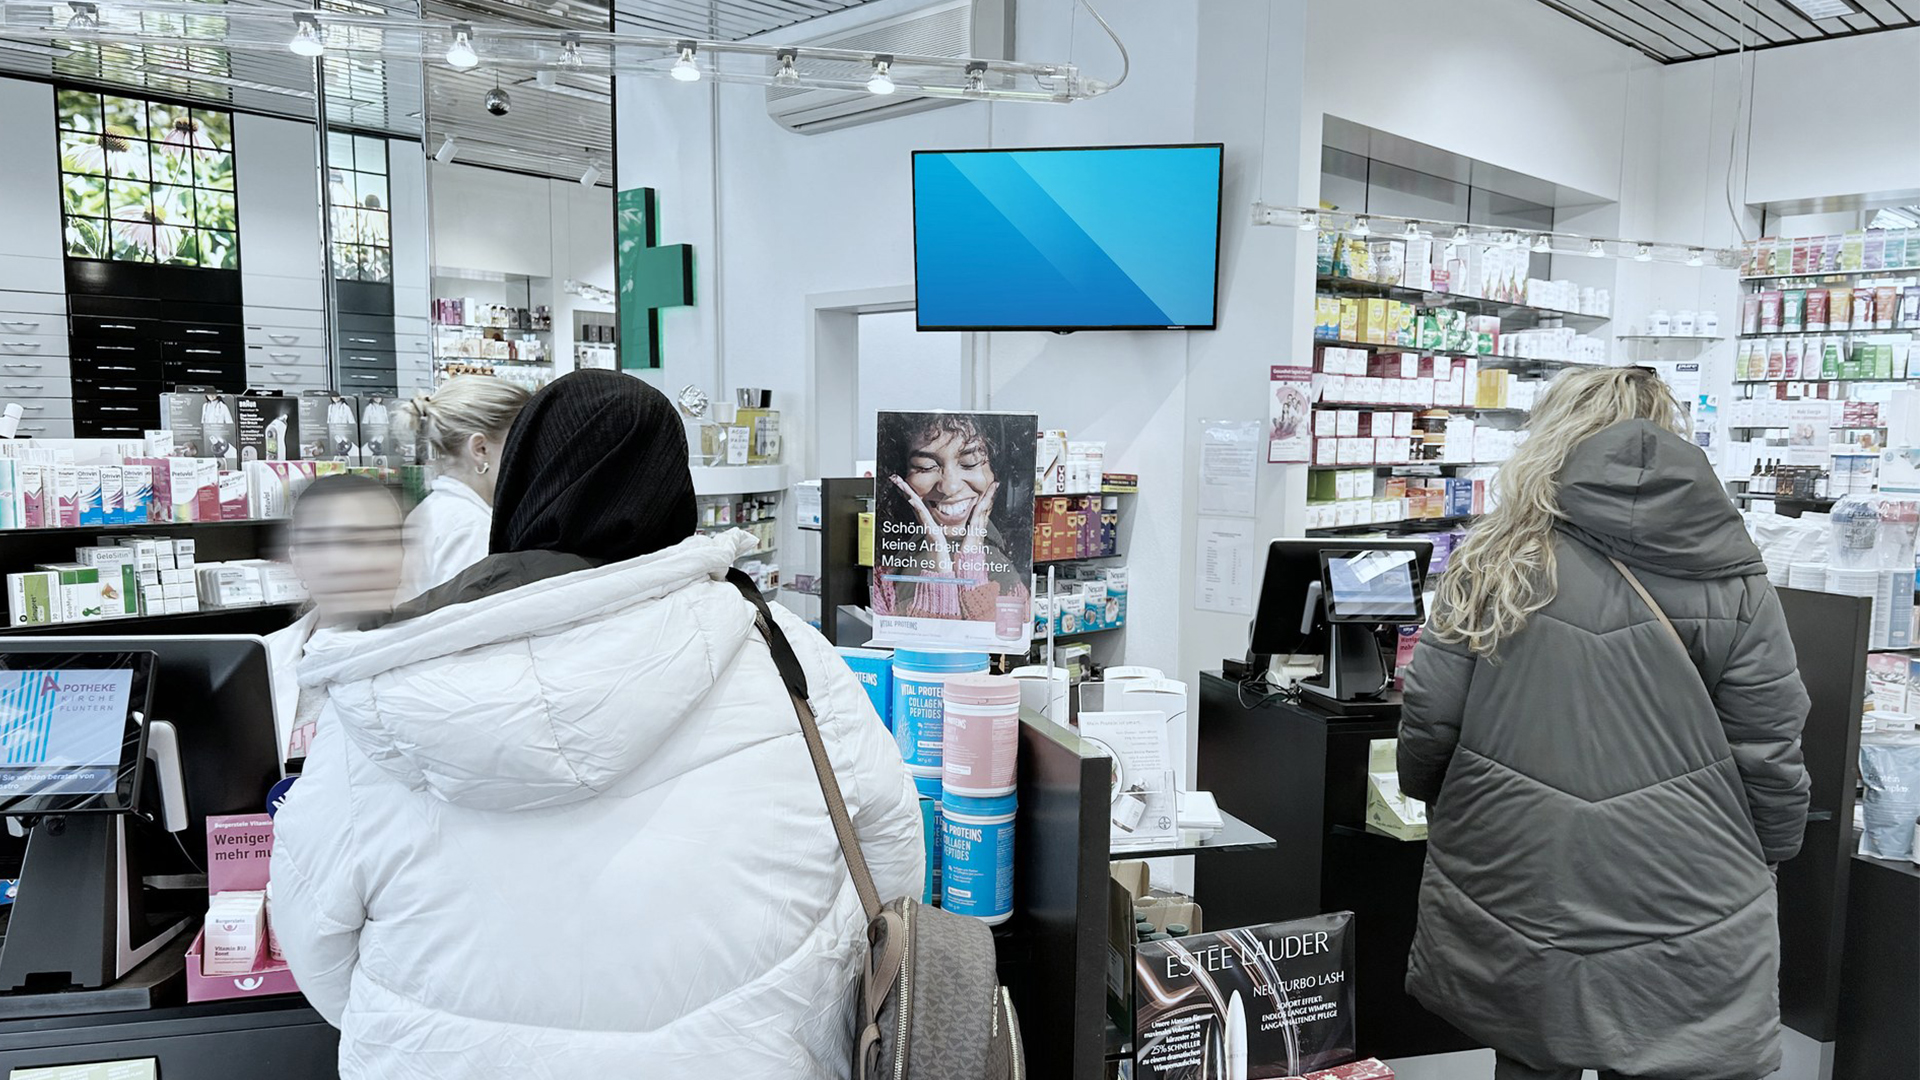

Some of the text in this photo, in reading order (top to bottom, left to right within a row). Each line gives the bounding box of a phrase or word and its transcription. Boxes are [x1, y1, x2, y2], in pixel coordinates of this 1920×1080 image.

[882, 520, 988, 537] Schönheit sollte
[882, 538, 993, 555] keine Arbeit sein.
[882, 554, 1011, 573] Mach es dir leichter.
[909, 697, 943, 709] COLLAGEN
[909, 707, 942, 719] PEPTIDES
[214, 832, 271, 846] Weniger
[949, 824, 982, 843] PROTEINS
[215, 848, 250, 861] mehr
[1240, 931, 1330, 966] LAUDER
[1253, 970, 1345, 998] NEU TURBO LASH
[1167, 1040, 1201, 1052] SCHNELLER
